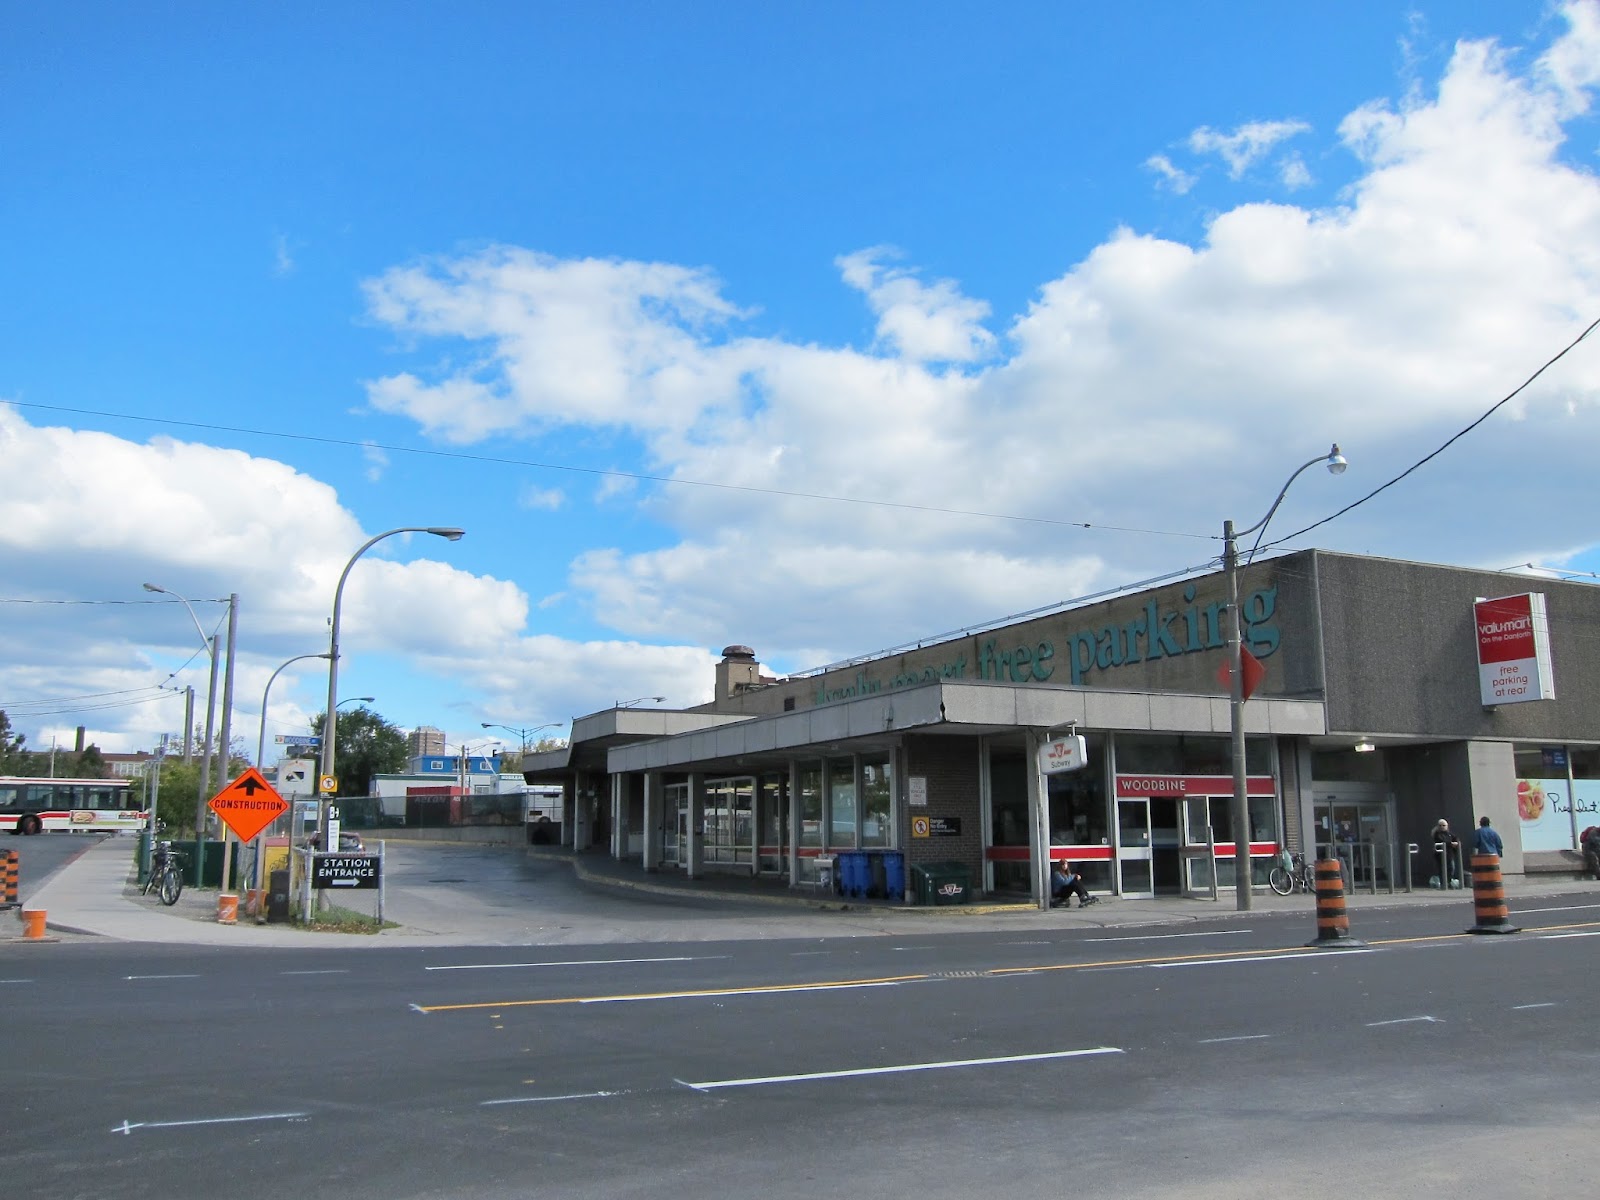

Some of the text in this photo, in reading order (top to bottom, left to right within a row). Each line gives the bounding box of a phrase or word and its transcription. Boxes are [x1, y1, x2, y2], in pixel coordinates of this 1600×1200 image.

[978, 638, 1056, 683] free
[1067, 581, 1281, 686] parking
[1503, 631, 1532, 640] Danforth
[1500, 666, 1519, 676] free
[1492, 675, 1528, 687] parking
[1495, 686, 1527, 697] at rear
[1050, 760, 1070, 769] Subway
[1121, 780, 1186, 791] WOODBINE
[214, 799, 282, 811] CONSTRUCTION
[324, 859, 371, 867] STATION
[319, 868, 374, 877] ENTRANCE
